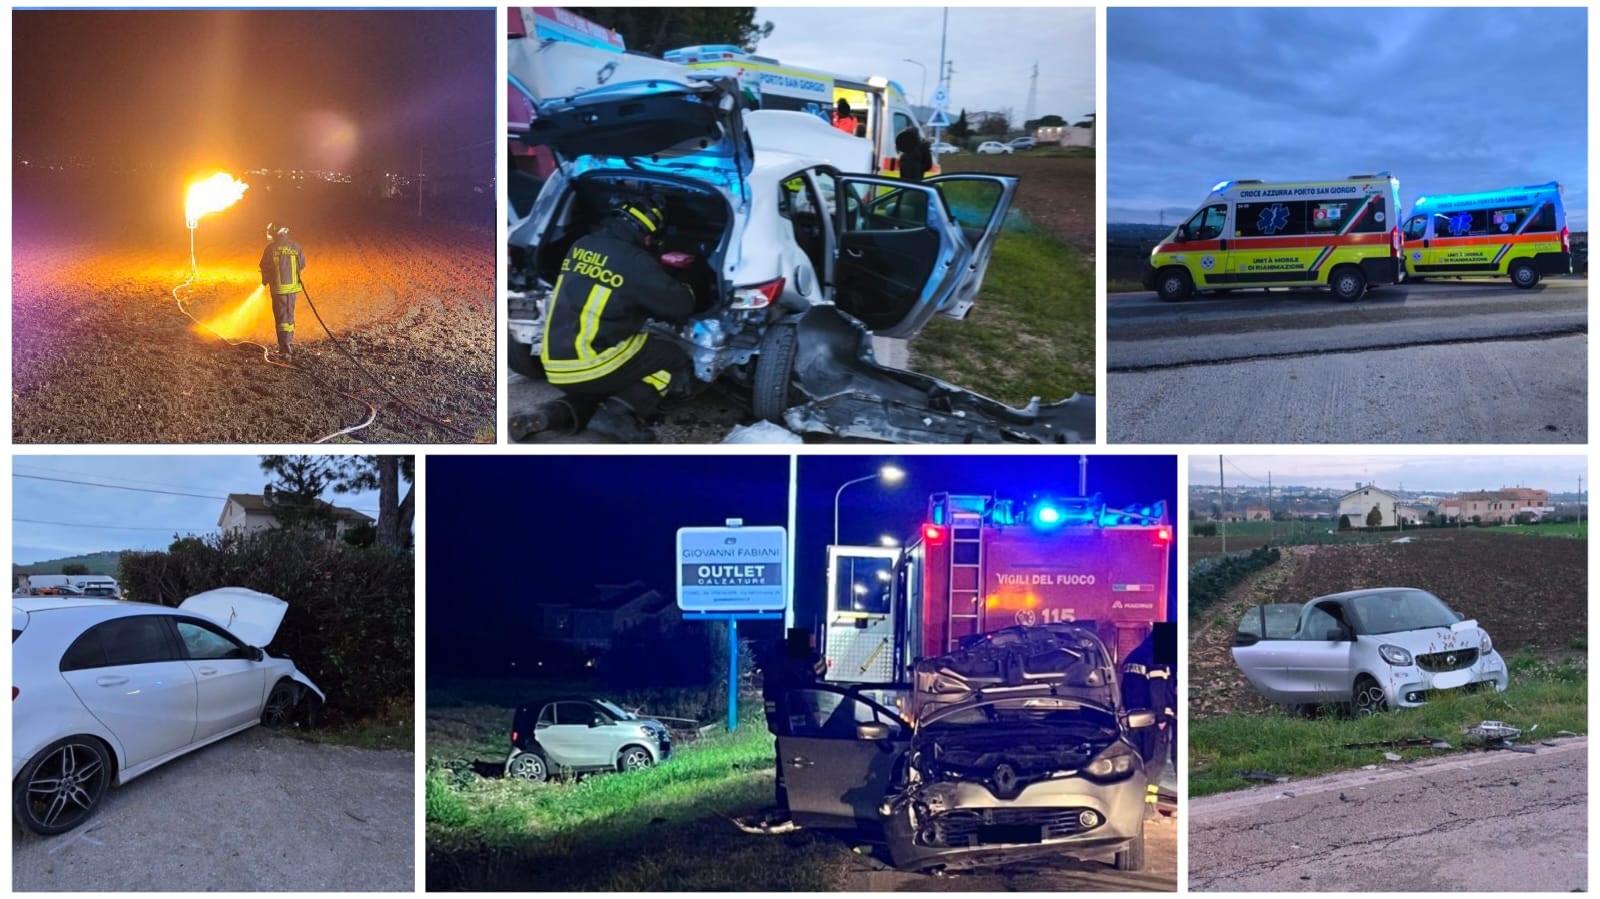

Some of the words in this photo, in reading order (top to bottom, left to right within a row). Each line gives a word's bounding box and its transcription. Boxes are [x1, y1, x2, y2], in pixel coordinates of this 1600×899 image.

[759, 73, 783, 86] PORTO
[784, 77, 798, 88] SAN
[799, 79, 825, 93] GIORGIO
[1240, 189, 1261, 198] CROCE
[1262, 188, 1293, 197] AZZURRA
[1294, 187, 1316, 196] PORTO
[1316, 187, 1330, 195] SAN
[1331, 186, 1357, 194] GIORGIO
[572, 247, 609, 267] VIGILI
[573, 262, 624, 288] FUOCO
[682, 548, 735, 559] GIOVANNI
[737, 547, 780, 557] FABIANI
[698, 565, 765, 577] OUTLET
[697, 577, 766, 585] CALZATURE
[996, 572, 1029, 585] VIGILI
[1032, 574, 1053, 585] DEL
[1057, 574, 1095, 585] FUOCO
[1041, 608, 1076, 624] 115
